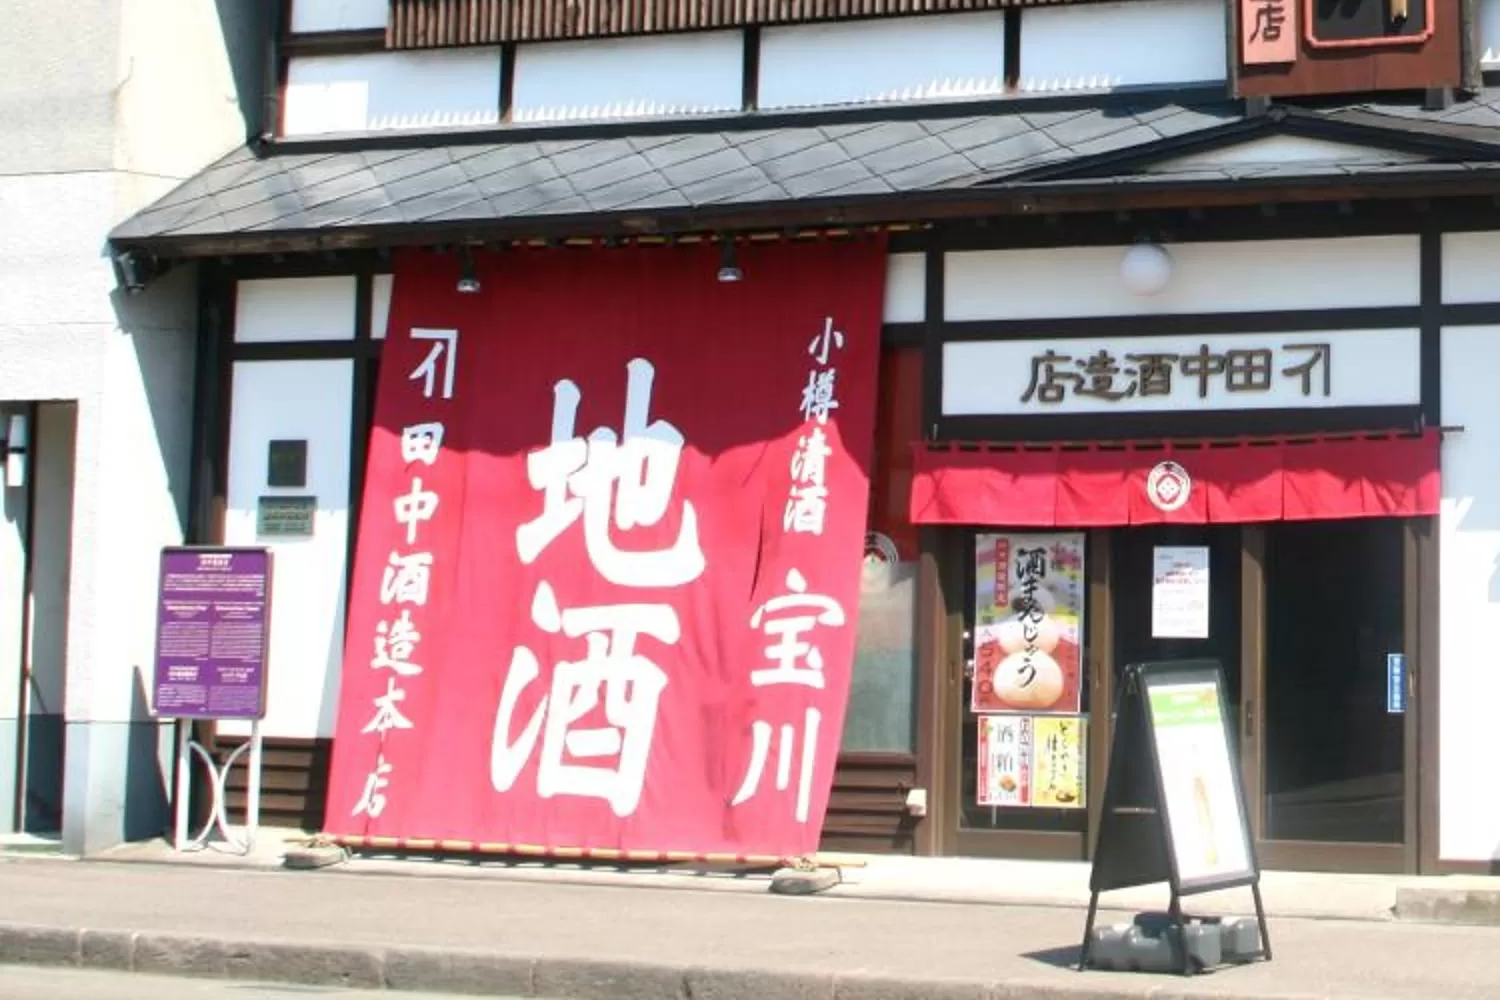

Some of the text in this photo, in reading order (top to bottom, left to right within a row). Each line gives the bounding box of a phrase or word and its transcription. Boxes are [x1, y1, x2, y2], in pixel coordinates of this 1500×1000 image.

[350, 419, 445, 819] 田中酒造本店
[489, 357, 706, 818] 地酒
